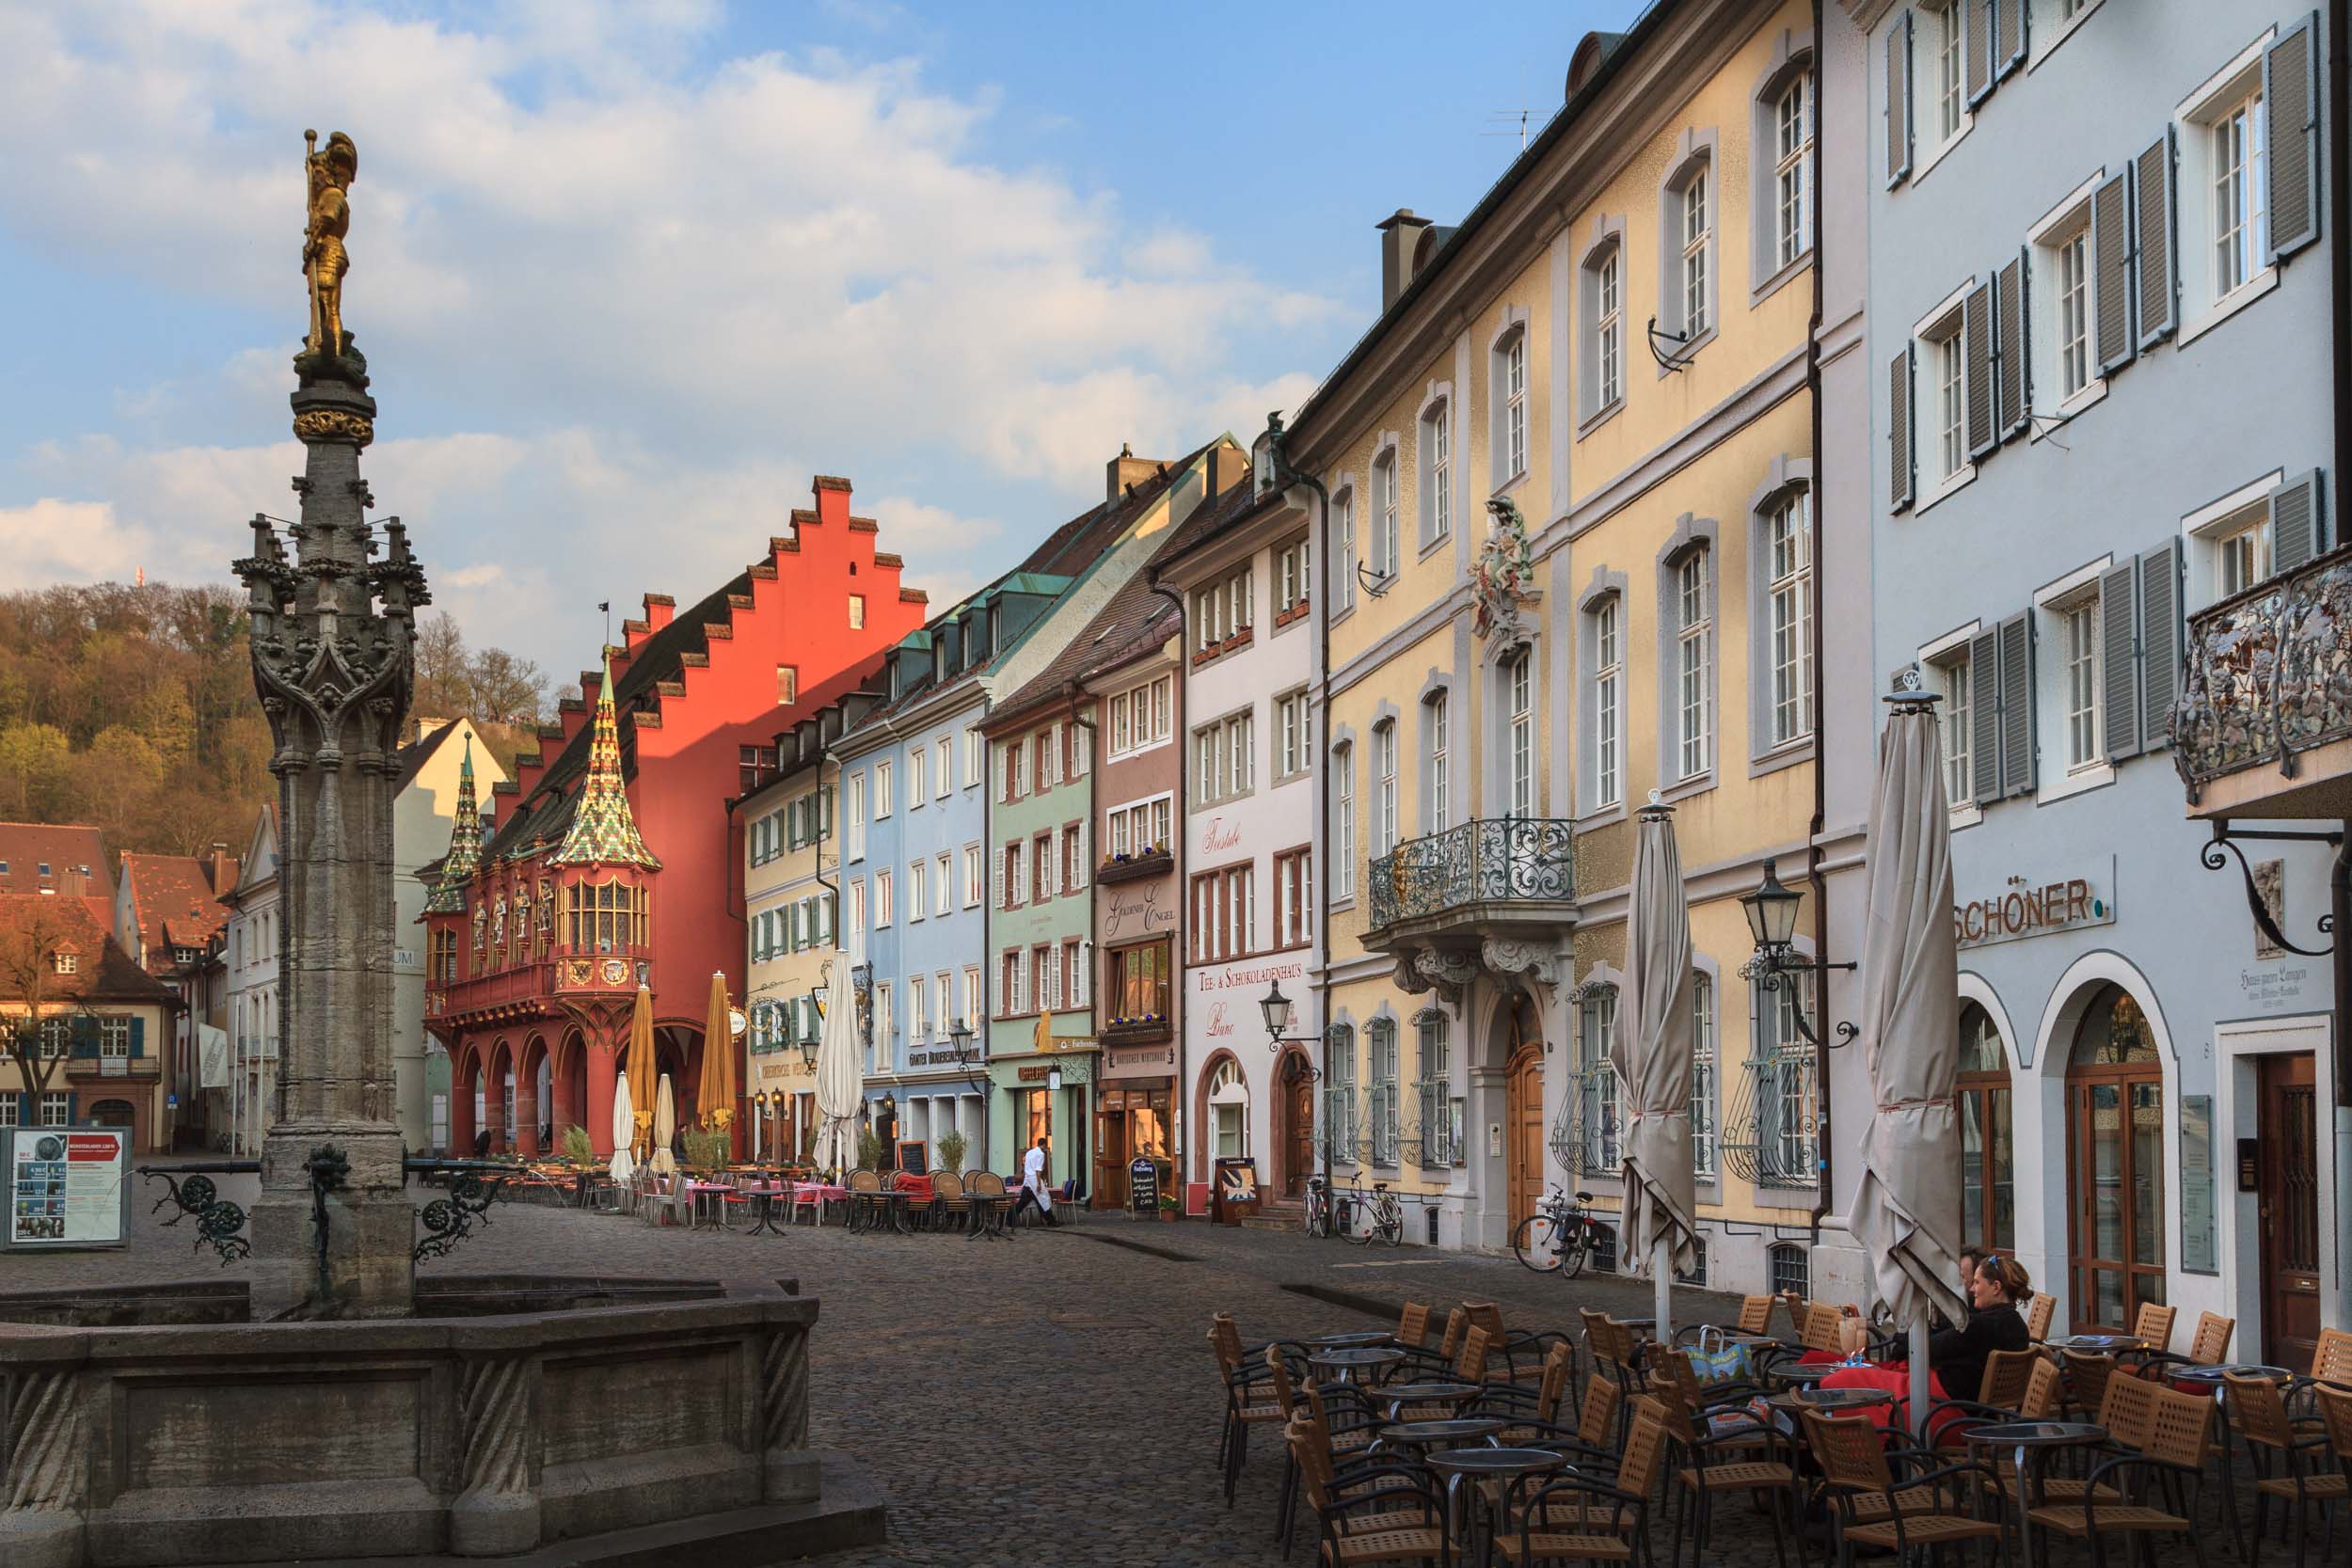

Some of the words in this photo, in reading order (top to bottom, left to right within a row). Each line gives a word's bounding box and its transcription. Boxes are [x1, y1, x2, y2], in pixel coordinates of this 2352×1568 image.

[1204, 817, 1241, 854] Teestube
[1105, 891, 1144, 937] GOLDENER
[1144, 882, 1175, 930] ENGEL
[1218, 976, 1223, 988] &
[909, 1053, 927, 1066] GANTER
